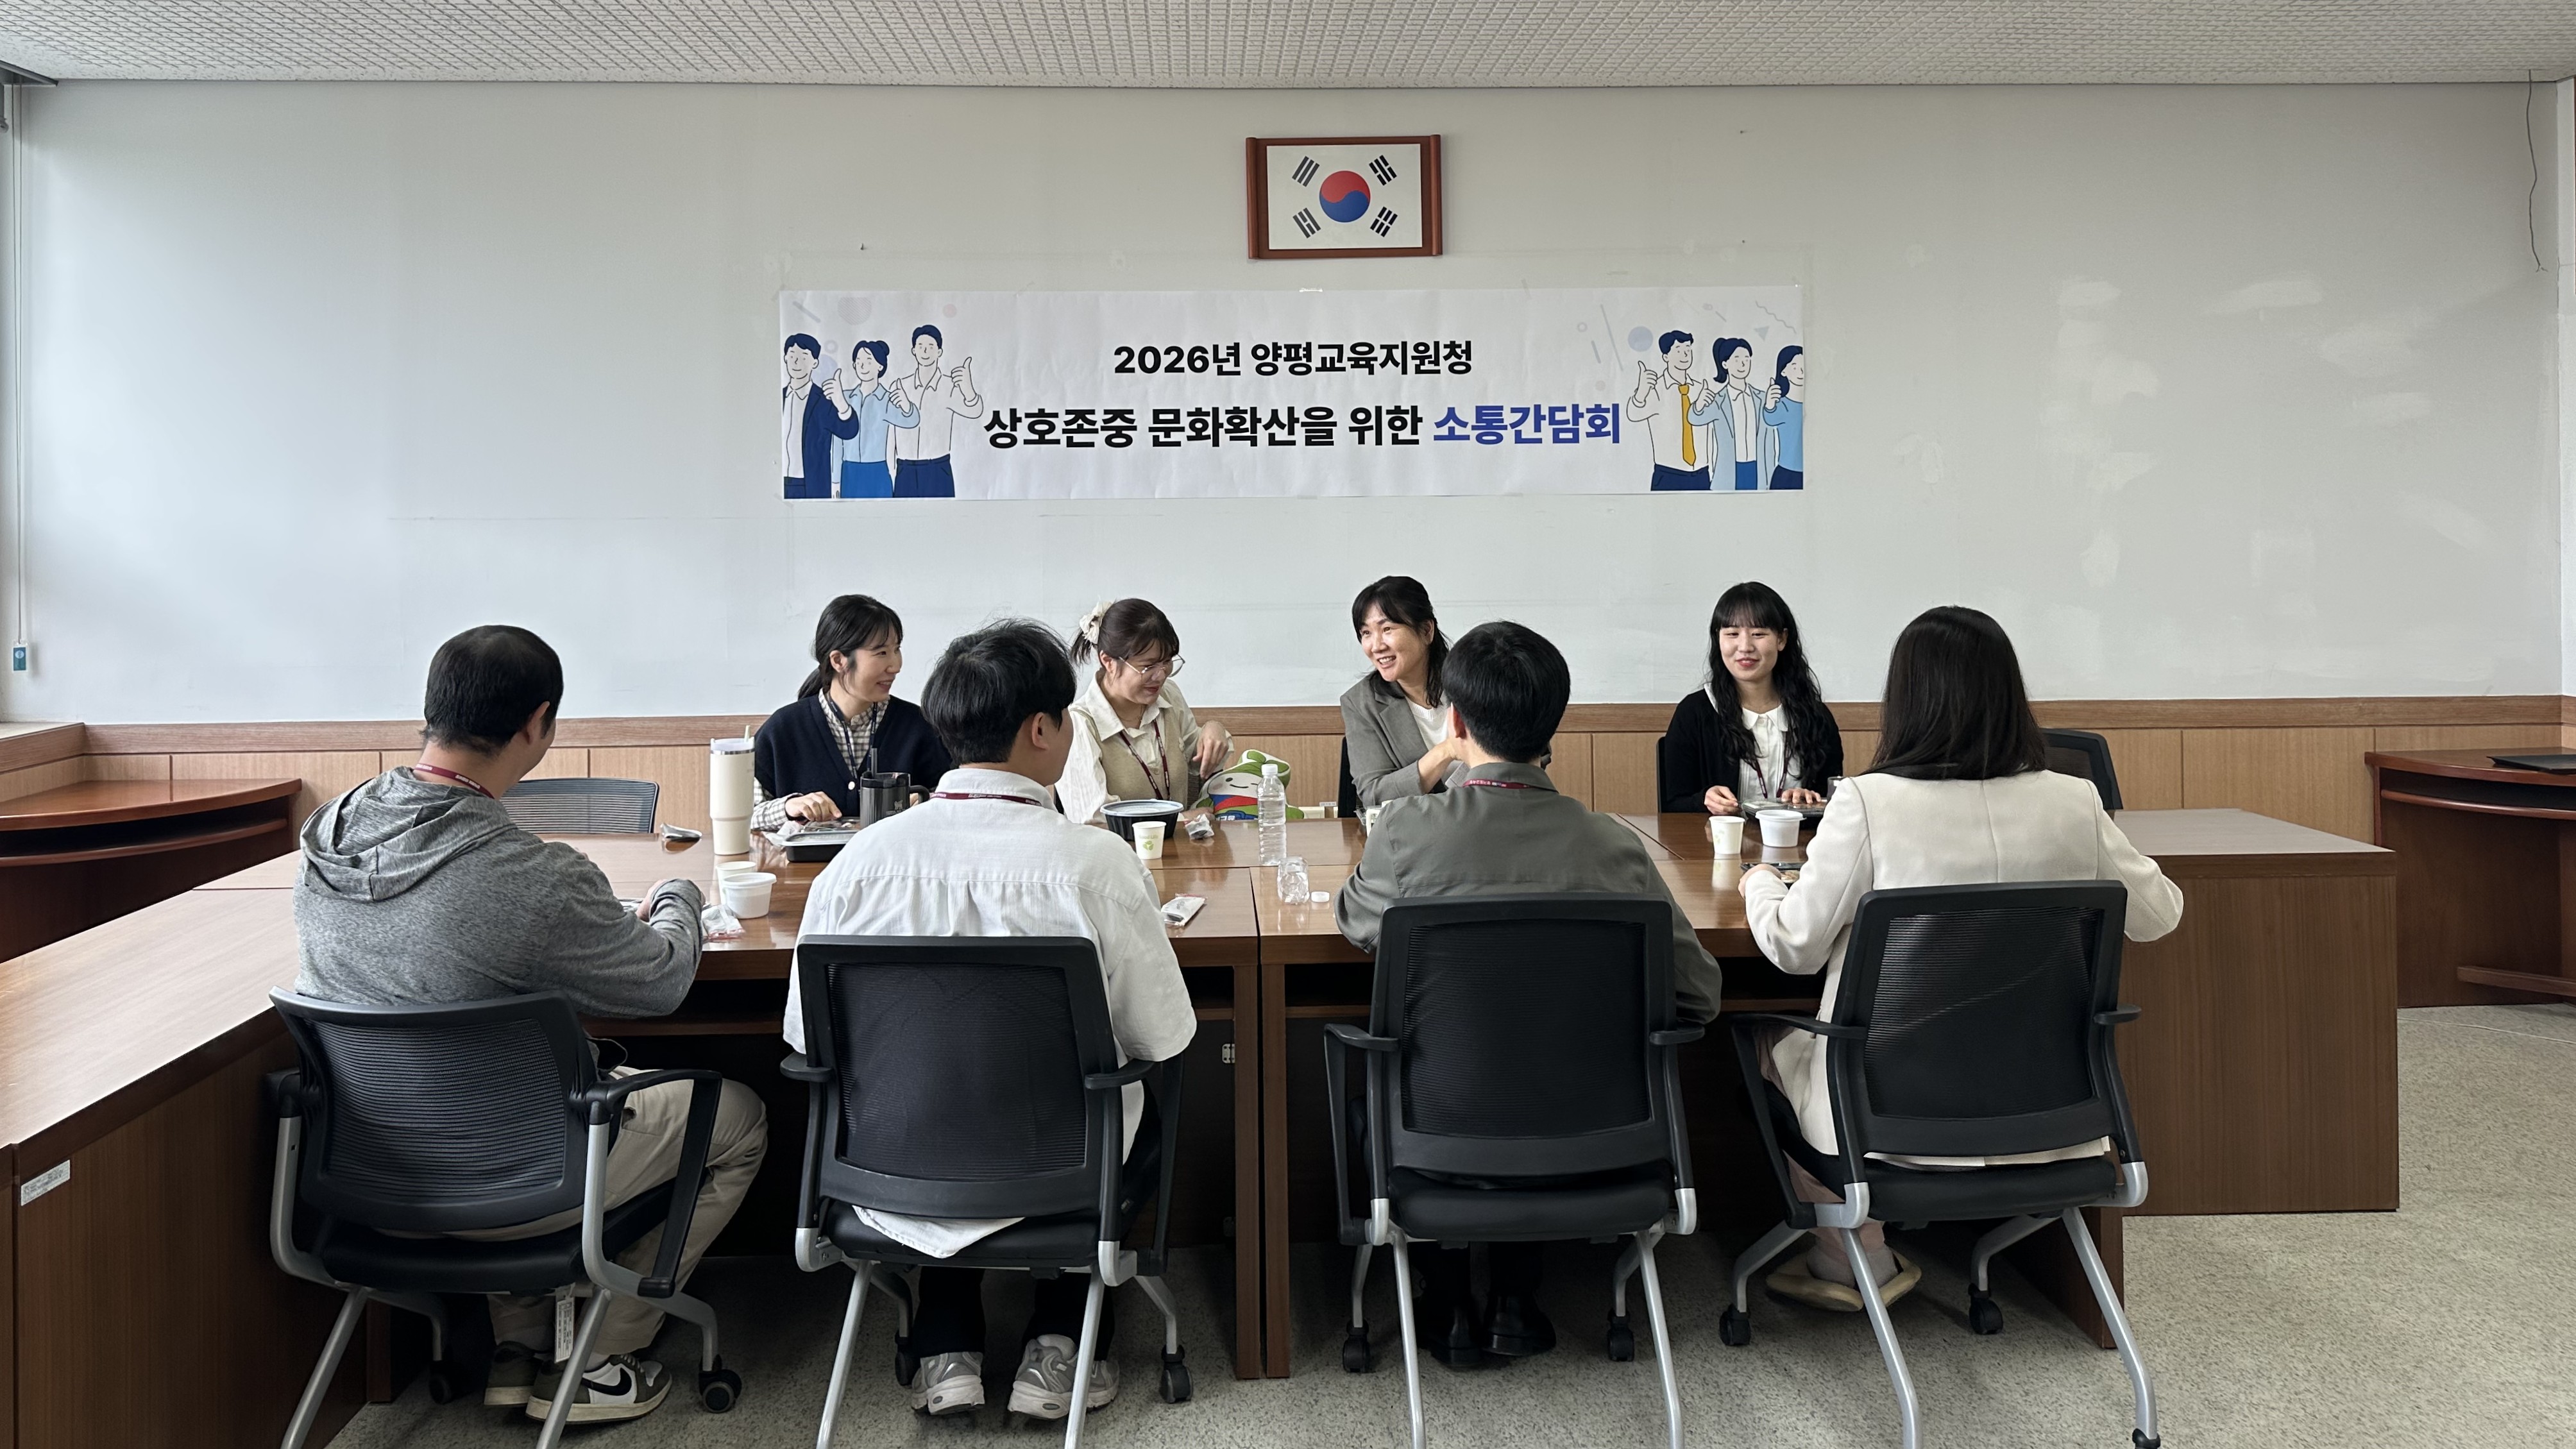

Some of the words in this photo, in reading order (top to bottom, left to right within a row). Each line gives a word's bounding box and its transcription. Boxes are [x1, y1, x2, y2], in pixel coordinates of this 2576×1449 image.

[1114, 342, 1241, 377] 2026년
[1251, 340, 1473, 377] 양평교육지원청
[984, 407, 1138, 449] 상호존중
[1148, 406, 1338, 448] 문화확산을
[1348, 405, 1423, 446] 위한
[1434, 403, 1620, 446] 소통간담회
